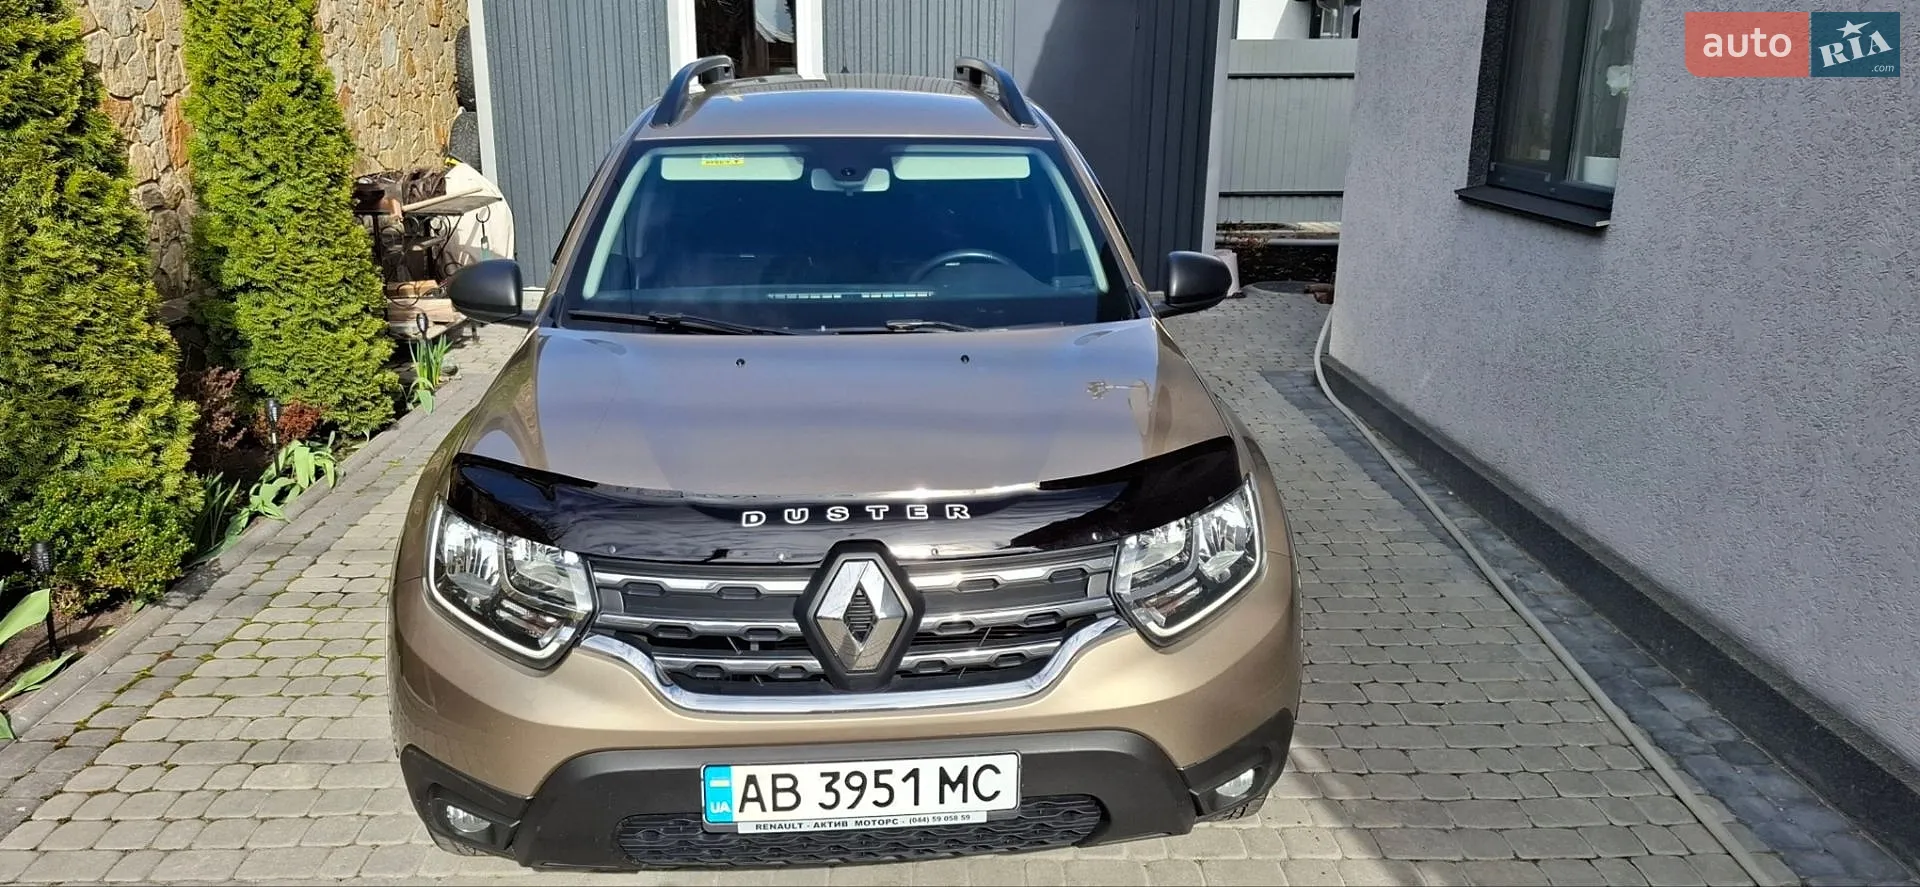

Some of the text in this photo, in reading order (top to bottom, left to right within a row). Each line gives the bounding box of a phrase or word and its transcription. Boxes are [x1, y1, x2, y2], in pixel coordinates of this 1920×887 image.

[742, 504, 971, 528] DUSTER
[738, 763, 1002, 813] AB 3951 MC
[710, 801, 731, 814] UA
[755, 822, 804, 831] RENAULT
[813, 820, 849, 829] АКТИВ
[854, 818, 899, 827] МОТОРС
